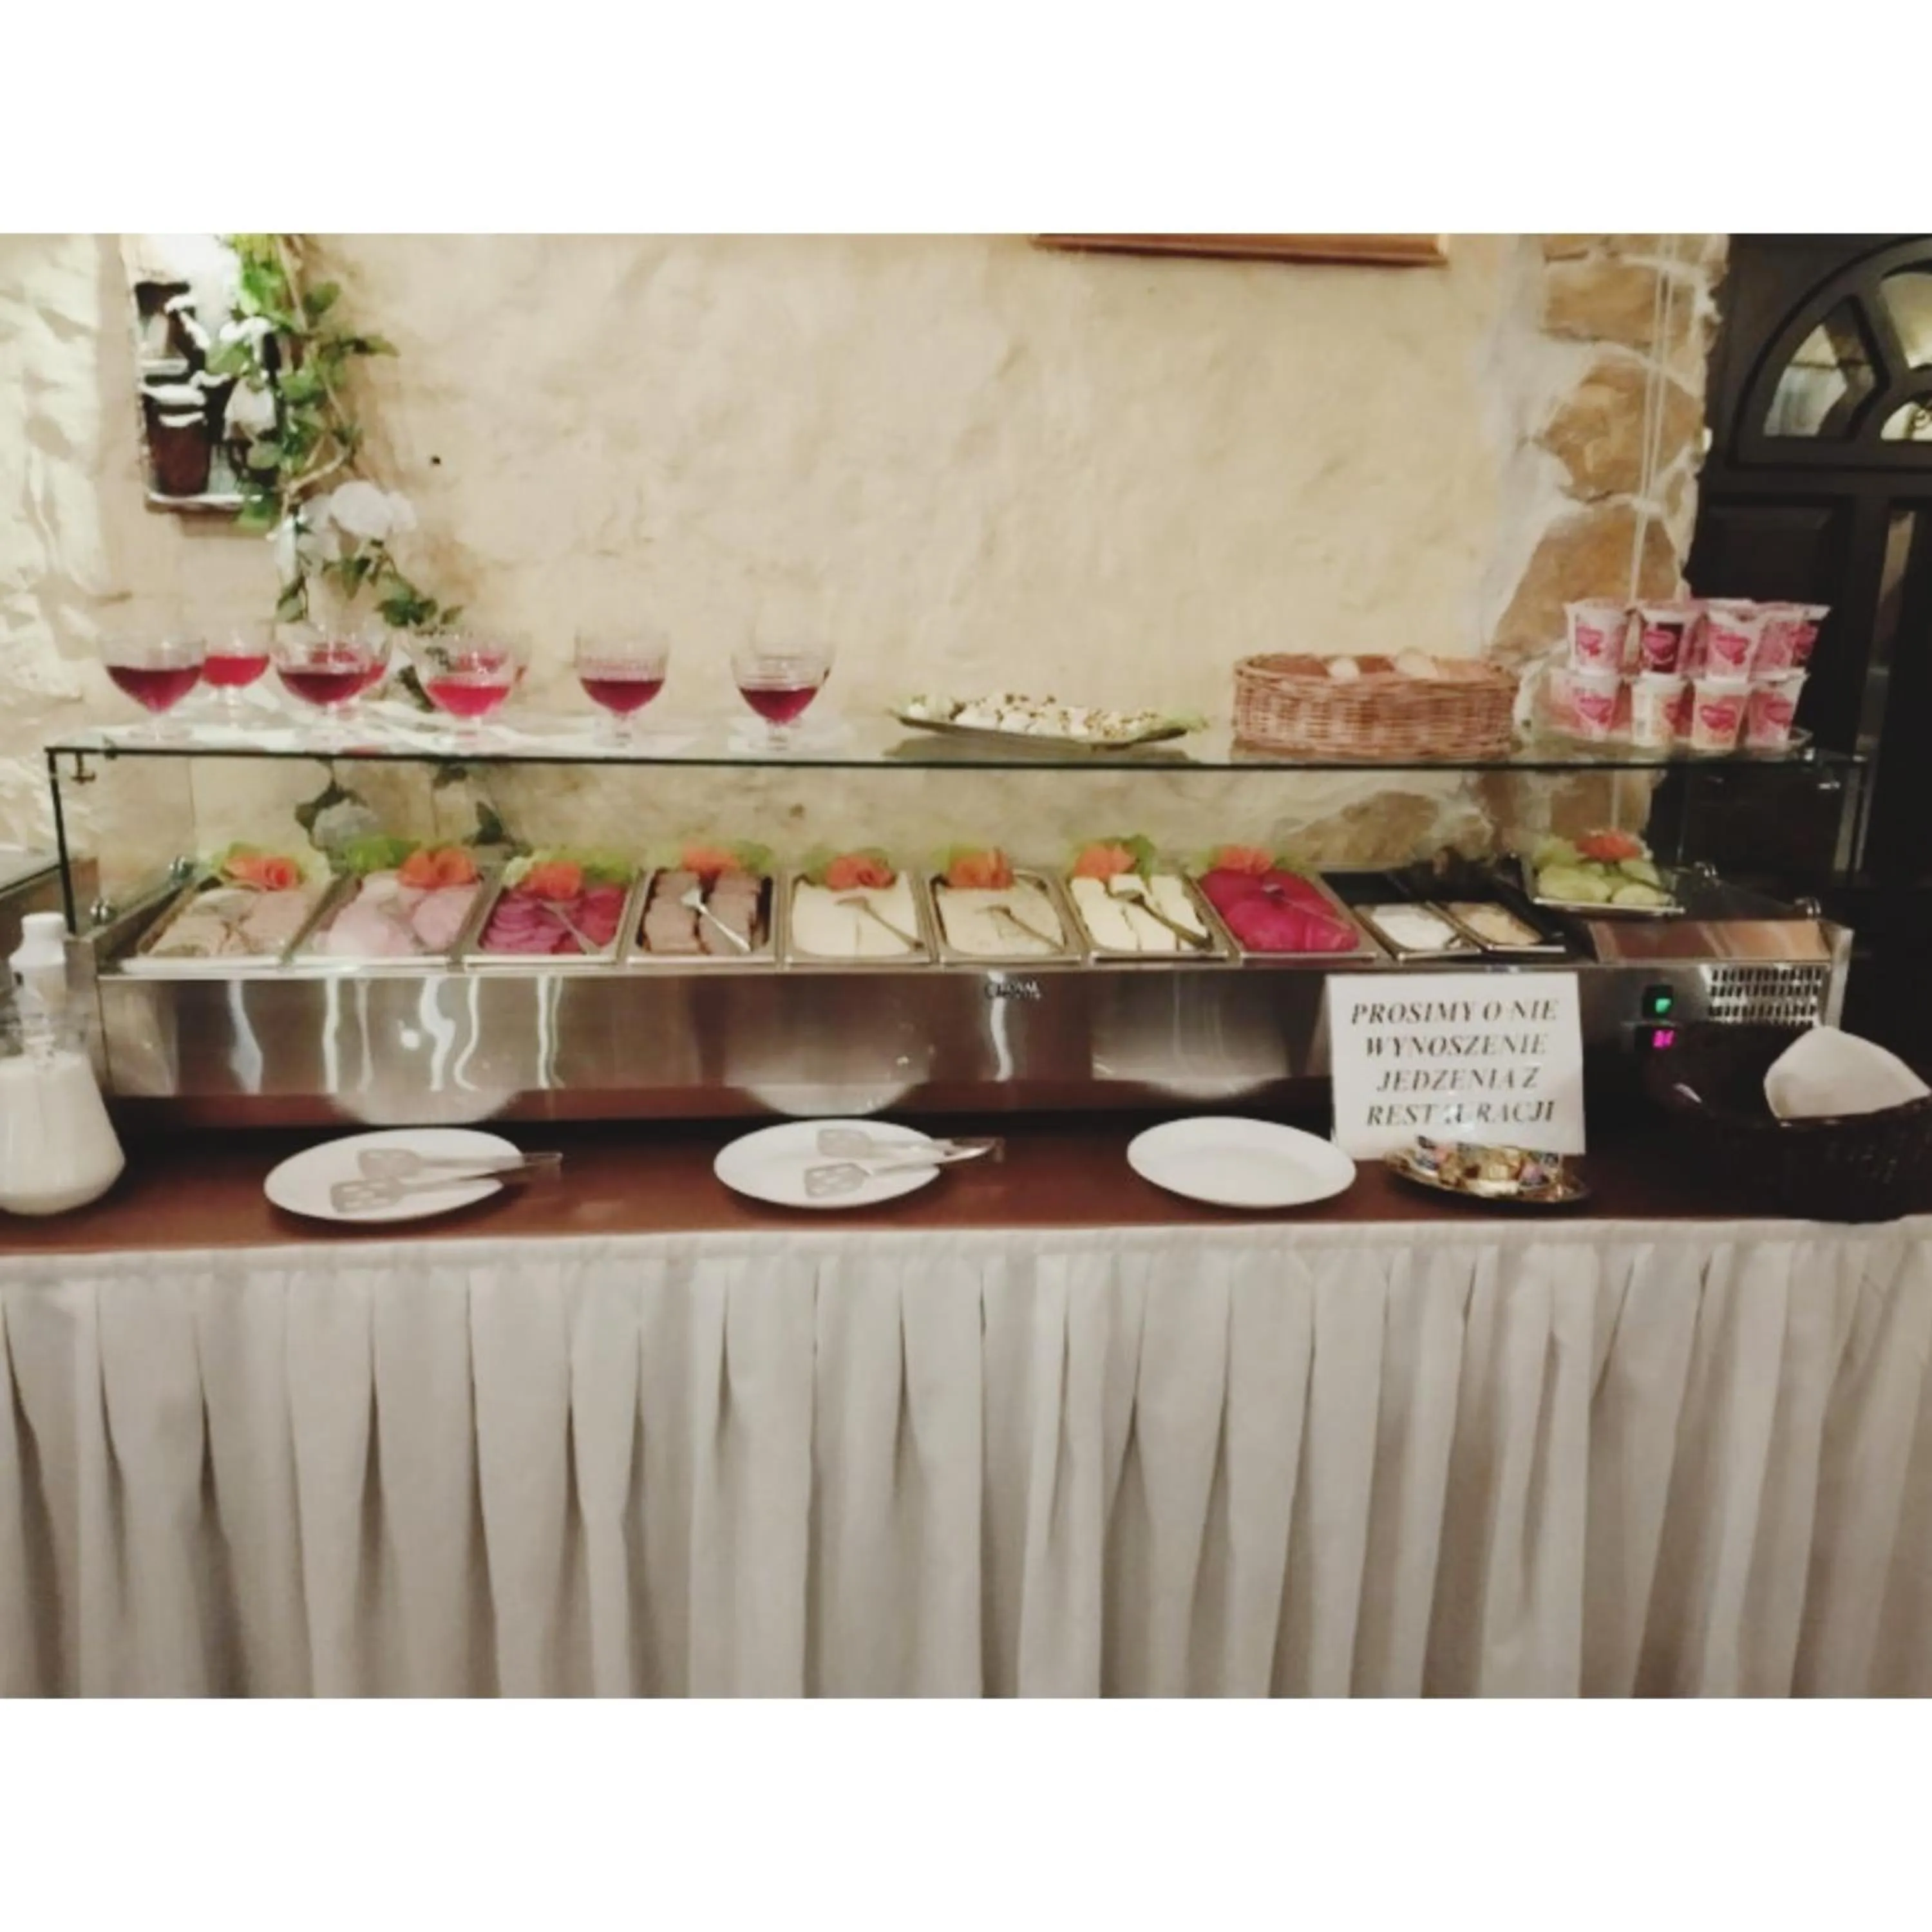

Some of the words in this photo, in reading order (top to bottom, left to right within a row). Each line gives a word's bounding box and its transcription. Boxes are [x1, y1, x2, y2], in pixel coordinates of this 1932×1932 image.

[1351, 1001, 1474, 1025] PROSIMY
[1482, 1000, 1502, 1023] O
[1511, 999, 1558, 1022] NIE
[1365, 1034, 1547, 1057] WYNOSZENIE
[1377, 1068, 1515, 1092] JEDZENIA
[1522, 1066, 1541, 1088] Z
